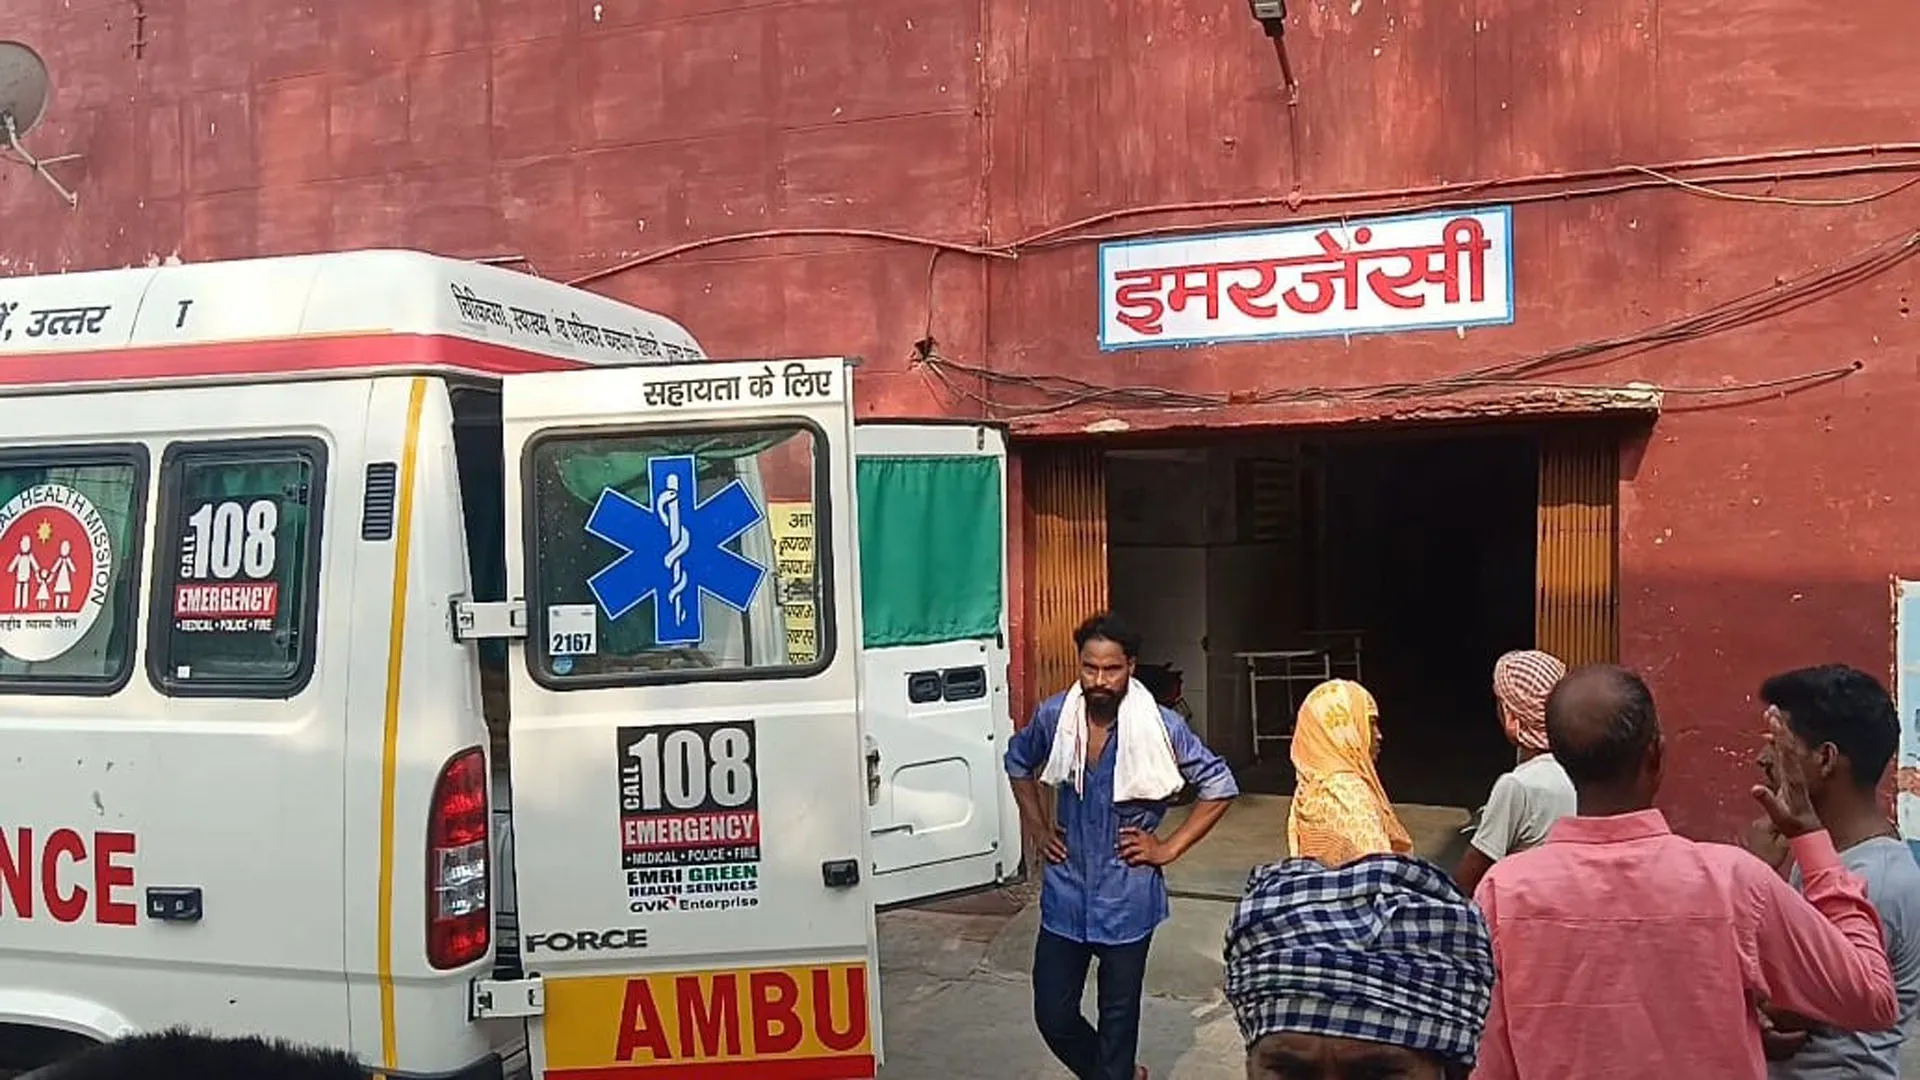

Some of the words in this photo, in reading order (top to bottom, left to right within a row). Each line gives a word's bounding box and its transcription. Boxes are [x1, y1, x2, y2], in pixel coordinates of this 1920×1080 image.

[1114, 218, 1491, 334] इमरजेंसी
[26, 306, 112, 337] उत्तर
[643, 376, 741, 407] सहायता
[748, 365, 775, 398] के
[782, 363, 832, 397] लिए
[21, 486, 85, 515] HEALTH
[84, 509, 111, 606] MISSION
[181, 534, 195, 577] CALL
[189, 500, 278, 579] 108
[178, 587, 274, 613] EMERGENCY
[553, 633, 592, 653] 2167
[623, 765, 640, 810] CALL
[628, 727, 752, 811] 108
[625, 815, 754, 845] EMERGENCY
[632, 852, 678, 865] MEDICAL
[688, 848, 725, 862] POLICE
[734, 846, 757, 860] FIRE
[0, 827, 137, 927] NCE
[627, 869, 682, 885] EMRI
[688, 865, 758, 882] GREEN
[629, 884, 682, 897] HEALTH
[686, 880, 757, 894] SERVICES
[630, 899, 669, 913] GVK
[680, 896, 759, 911] Enterprise
[525, 929, 648, 952] FORCE
[615, 967, 867, 1062] AMBU
